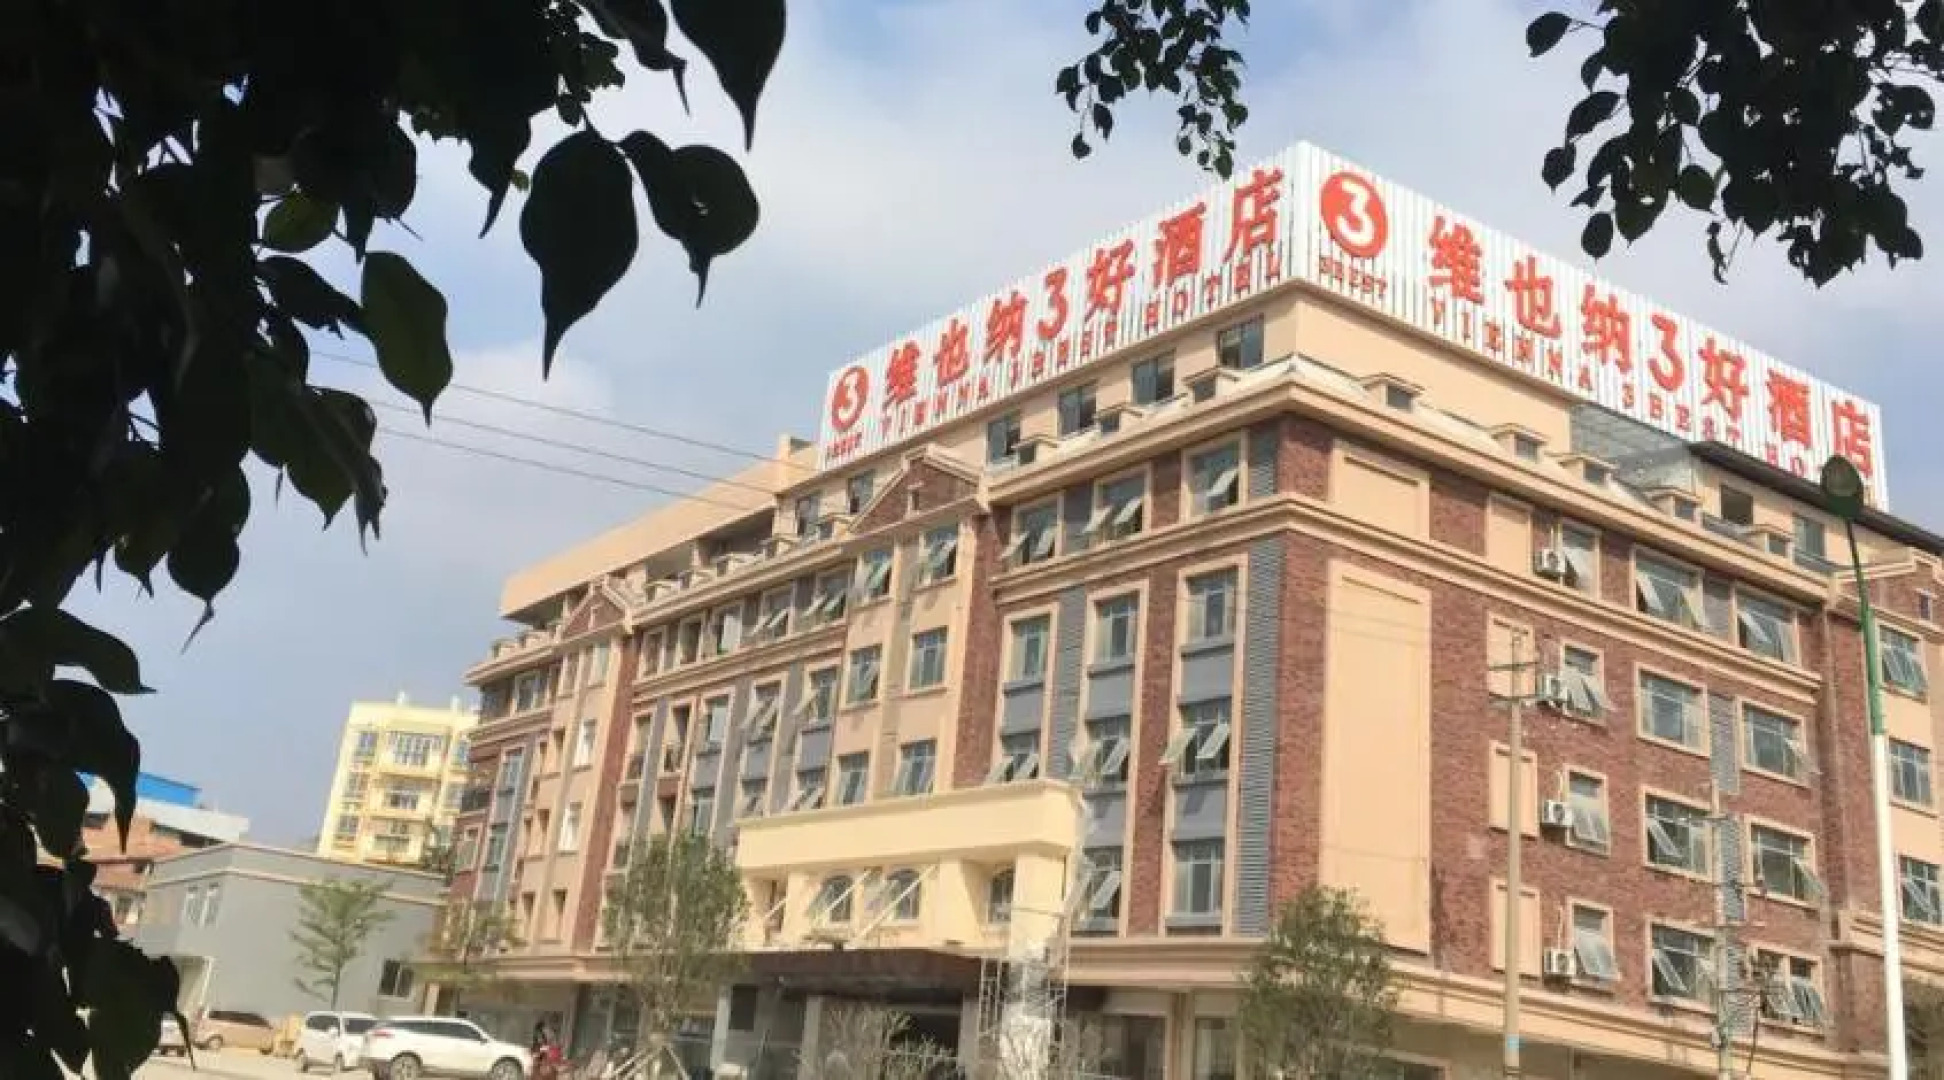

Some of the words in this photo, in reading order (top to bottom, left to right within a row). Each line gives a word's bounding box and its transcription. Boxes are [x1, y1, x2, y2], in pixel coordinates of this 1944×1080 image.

[882, 168, 1284, 413] 维也纳3好酒店
[1144, 246, 1282, 334] HOTEL
[1428, 214, 1874, 479] 维也纳3好酒店
